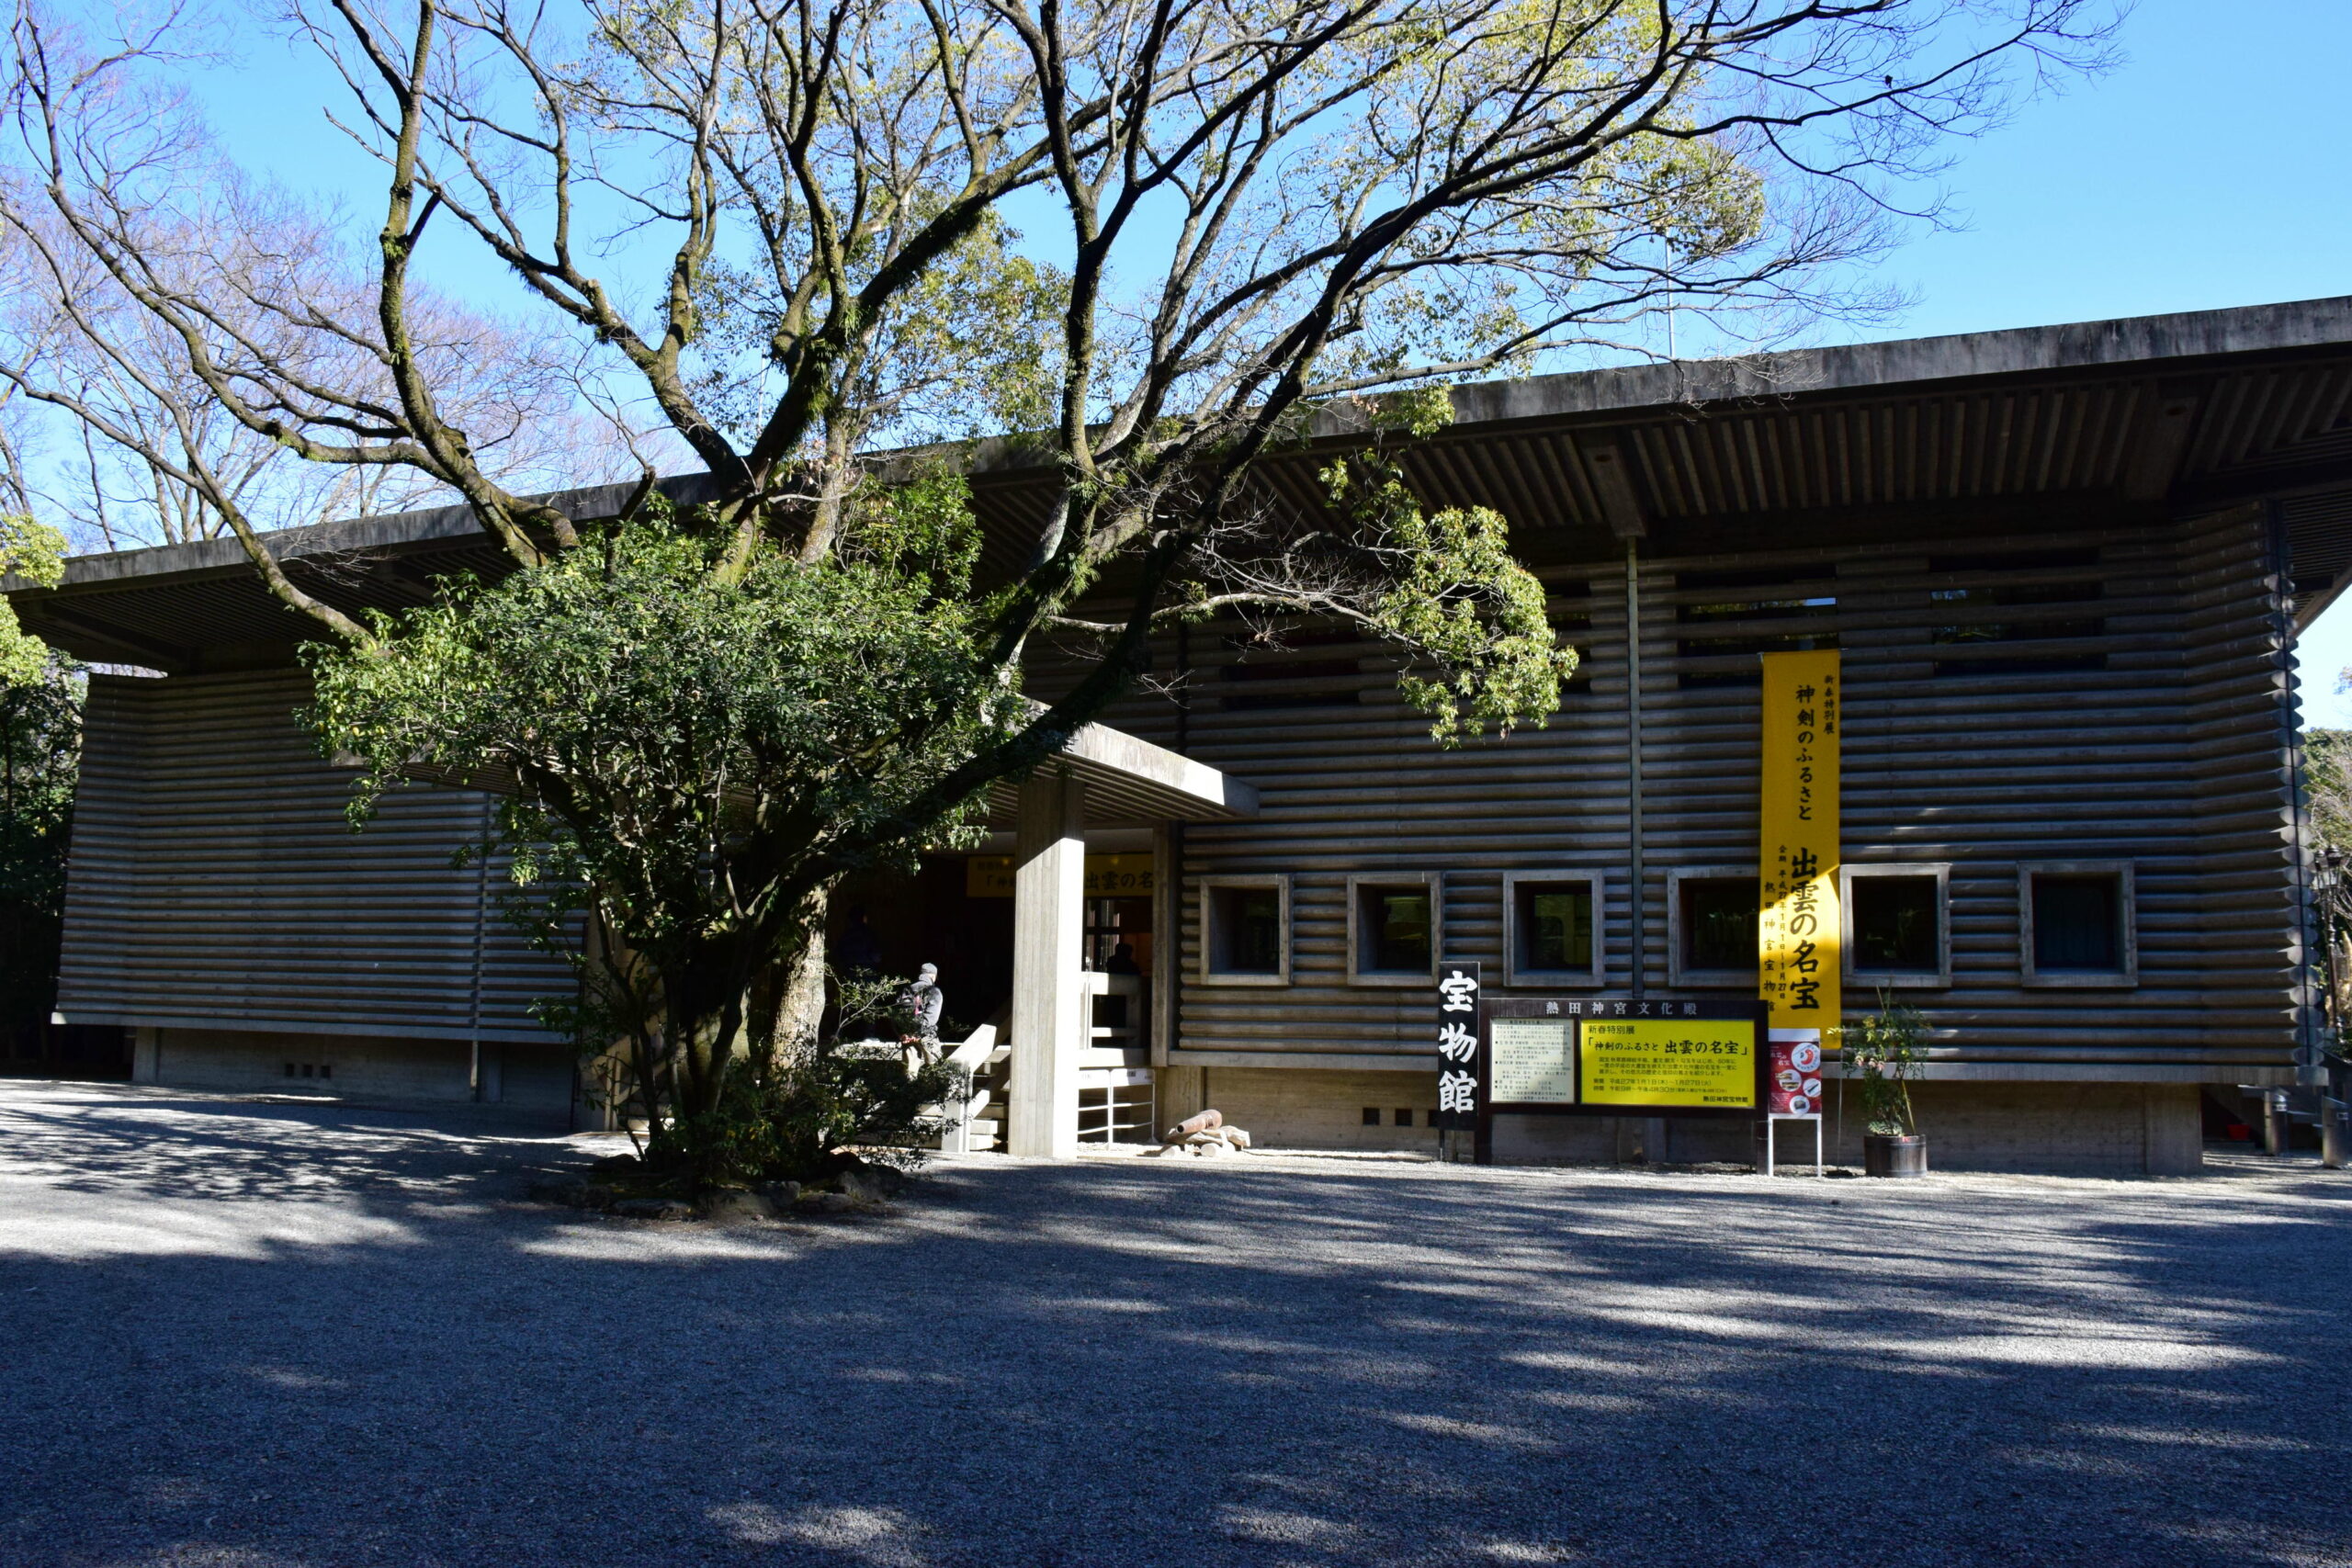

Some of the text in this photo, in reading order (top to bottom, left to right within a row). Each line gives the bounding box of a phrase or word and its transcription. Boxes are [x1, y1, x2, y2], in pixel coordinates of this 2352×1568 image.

[1823, 674, 1835, 735] 新春特別展
[1789, 684, 1820, 1010] 神剣のふるさと 出雲の名宝
[1545, 1001, 1697, 1015] 熱田神宮文化殿
[1439, 970, 1477, 1114] 宝物館
[1589, 1025, 1635, 1034] 新春特別展
[1665, 1040, 1748, 1055] 出雲の名宝」
